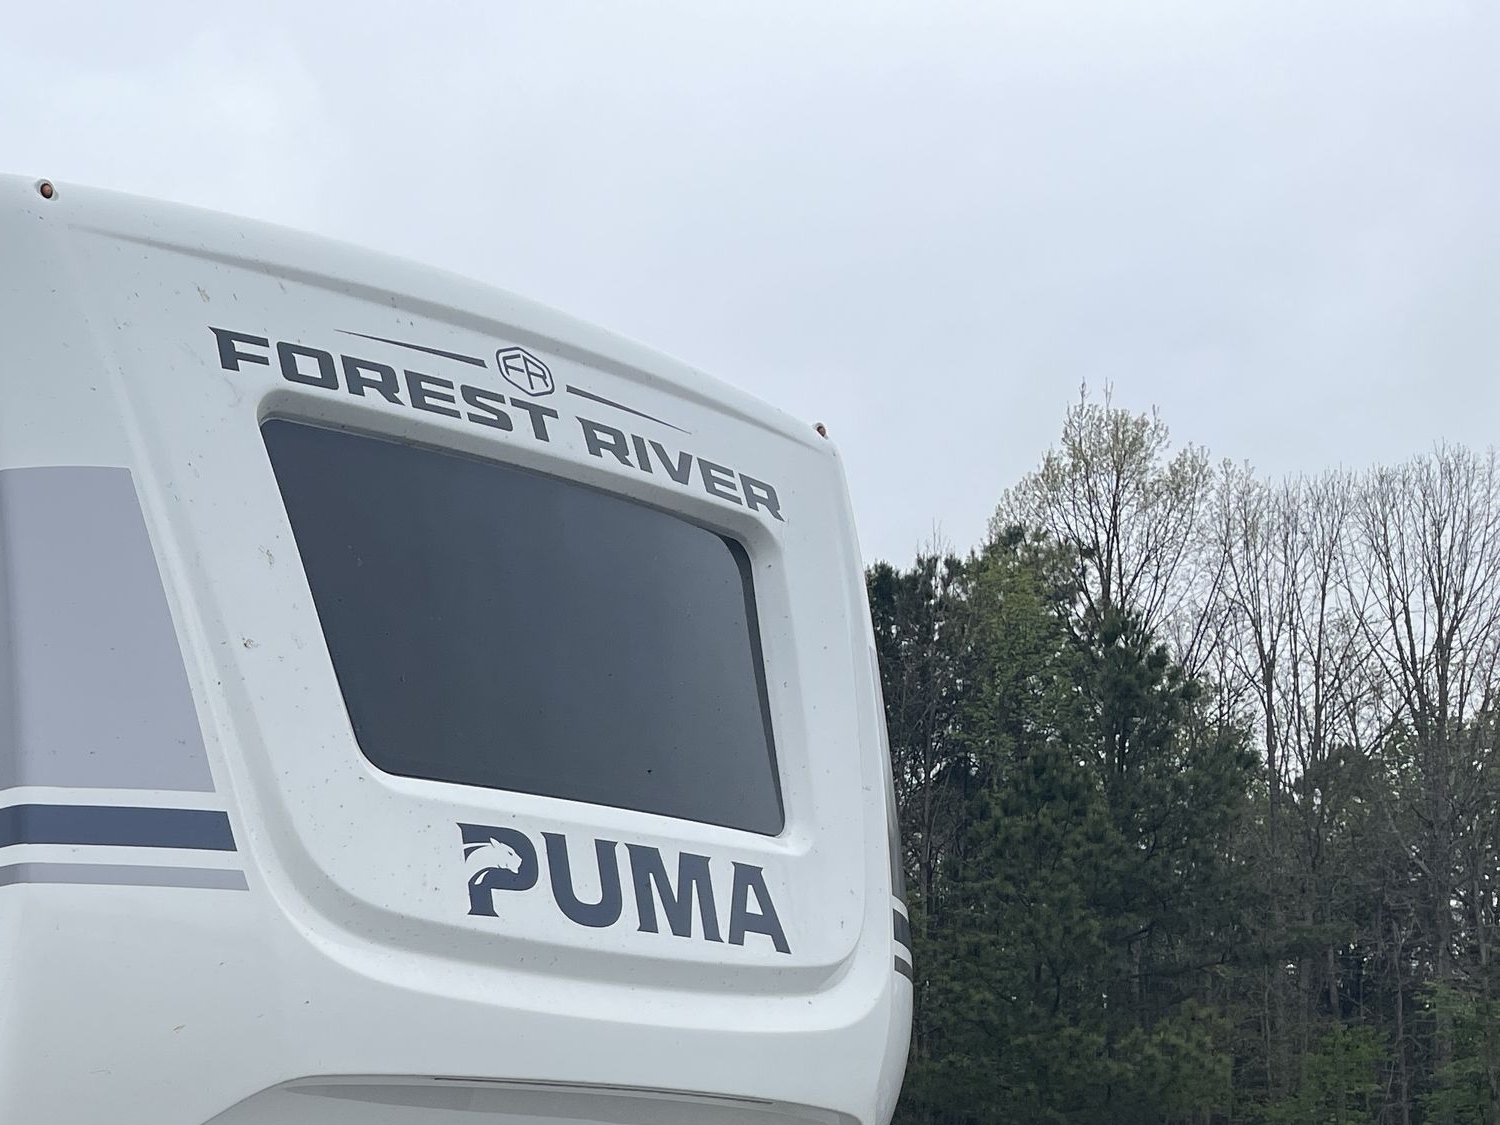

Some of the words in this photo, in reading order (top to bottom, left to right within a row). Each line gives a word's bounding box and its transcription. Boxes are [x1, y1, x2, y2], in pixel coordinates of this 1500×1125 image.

[208, 326, 559, 443] FOREST
[575, 416, 785, 522] RIVER
[456, 822, 792, 955] PUMA
